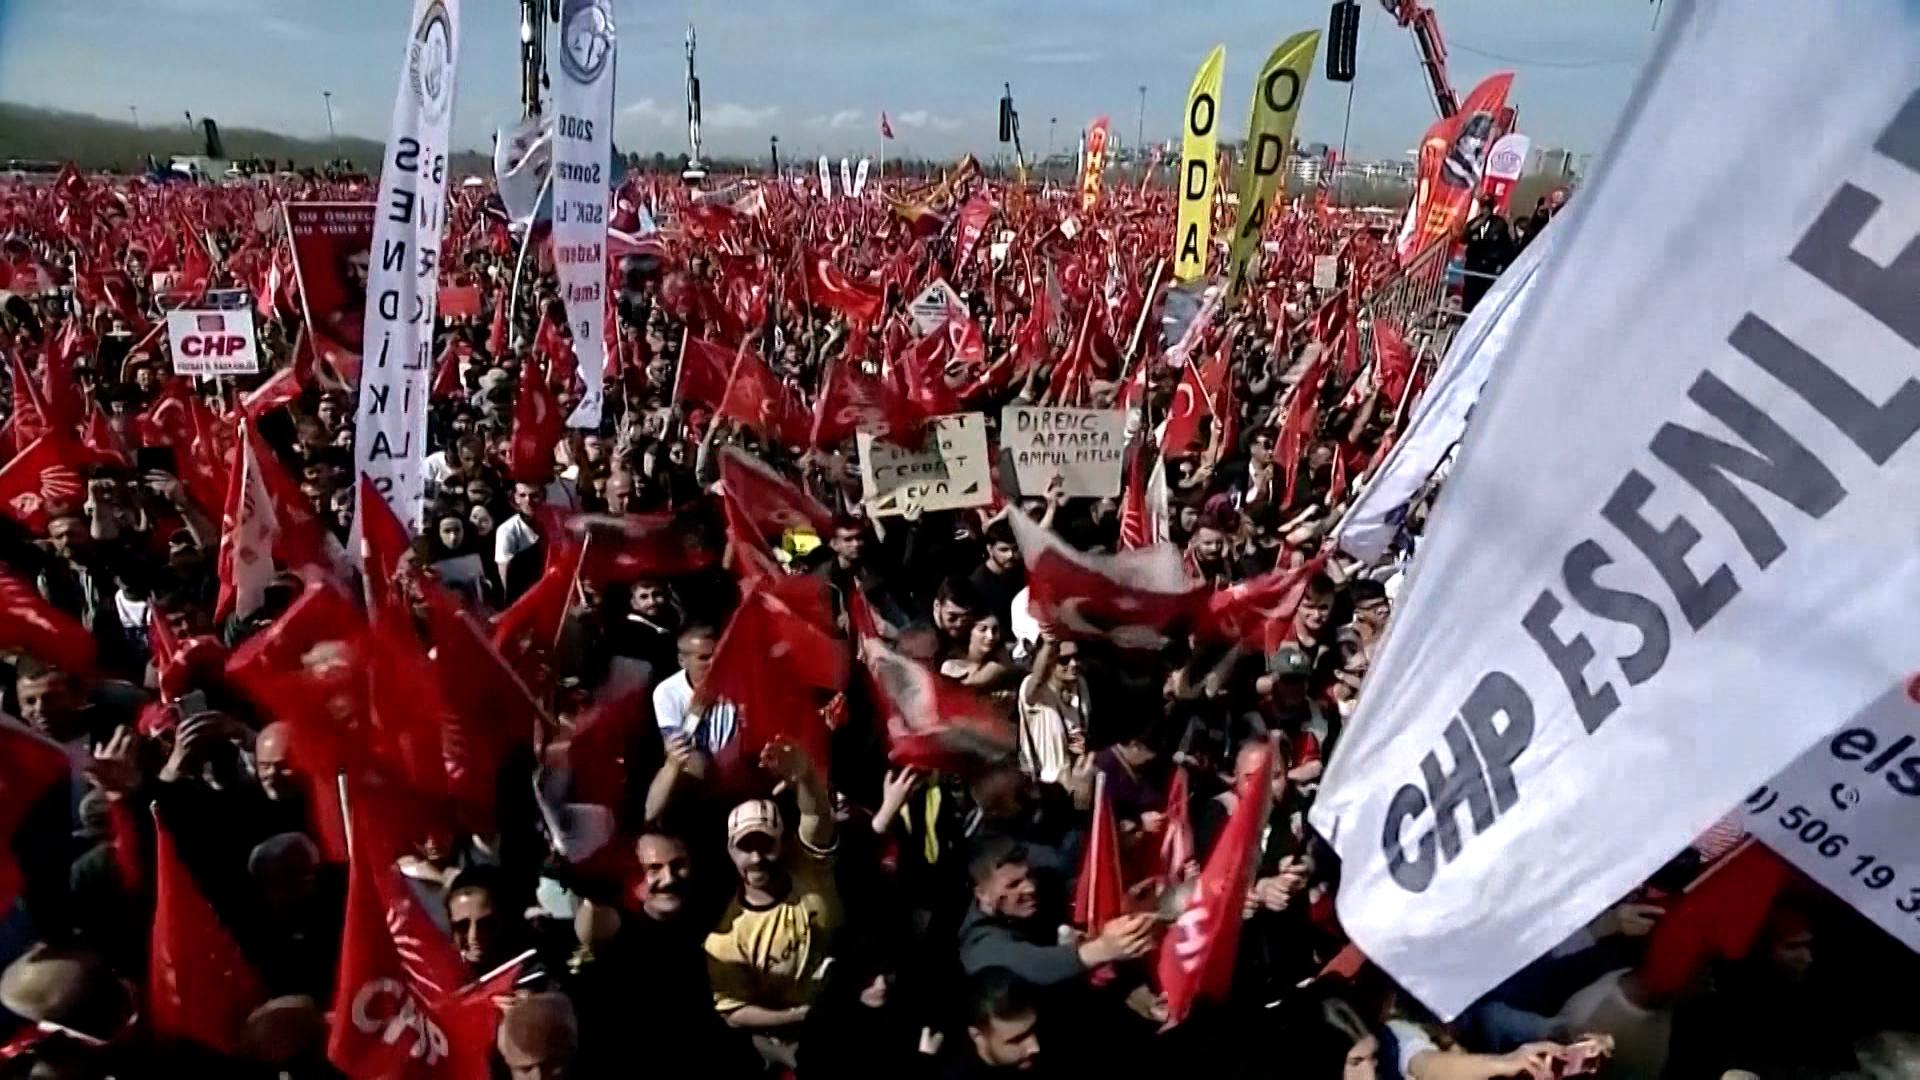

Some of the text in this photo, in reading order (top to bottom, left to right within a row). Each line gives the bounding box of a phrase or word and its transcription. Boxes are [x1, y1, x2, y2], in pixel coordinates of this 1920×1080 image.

[1180, 93, 1215, 264] ODA
[180, 335, 247, 358] CHP
[1521, 88, 1920, 736] ESENLE
[1382, 671, 1536, 893] CHP
[1778, 804, 1850, 859] 506
[1850, 854, 1896, 891] 19
[351, 977, 449, 1066] CHP
